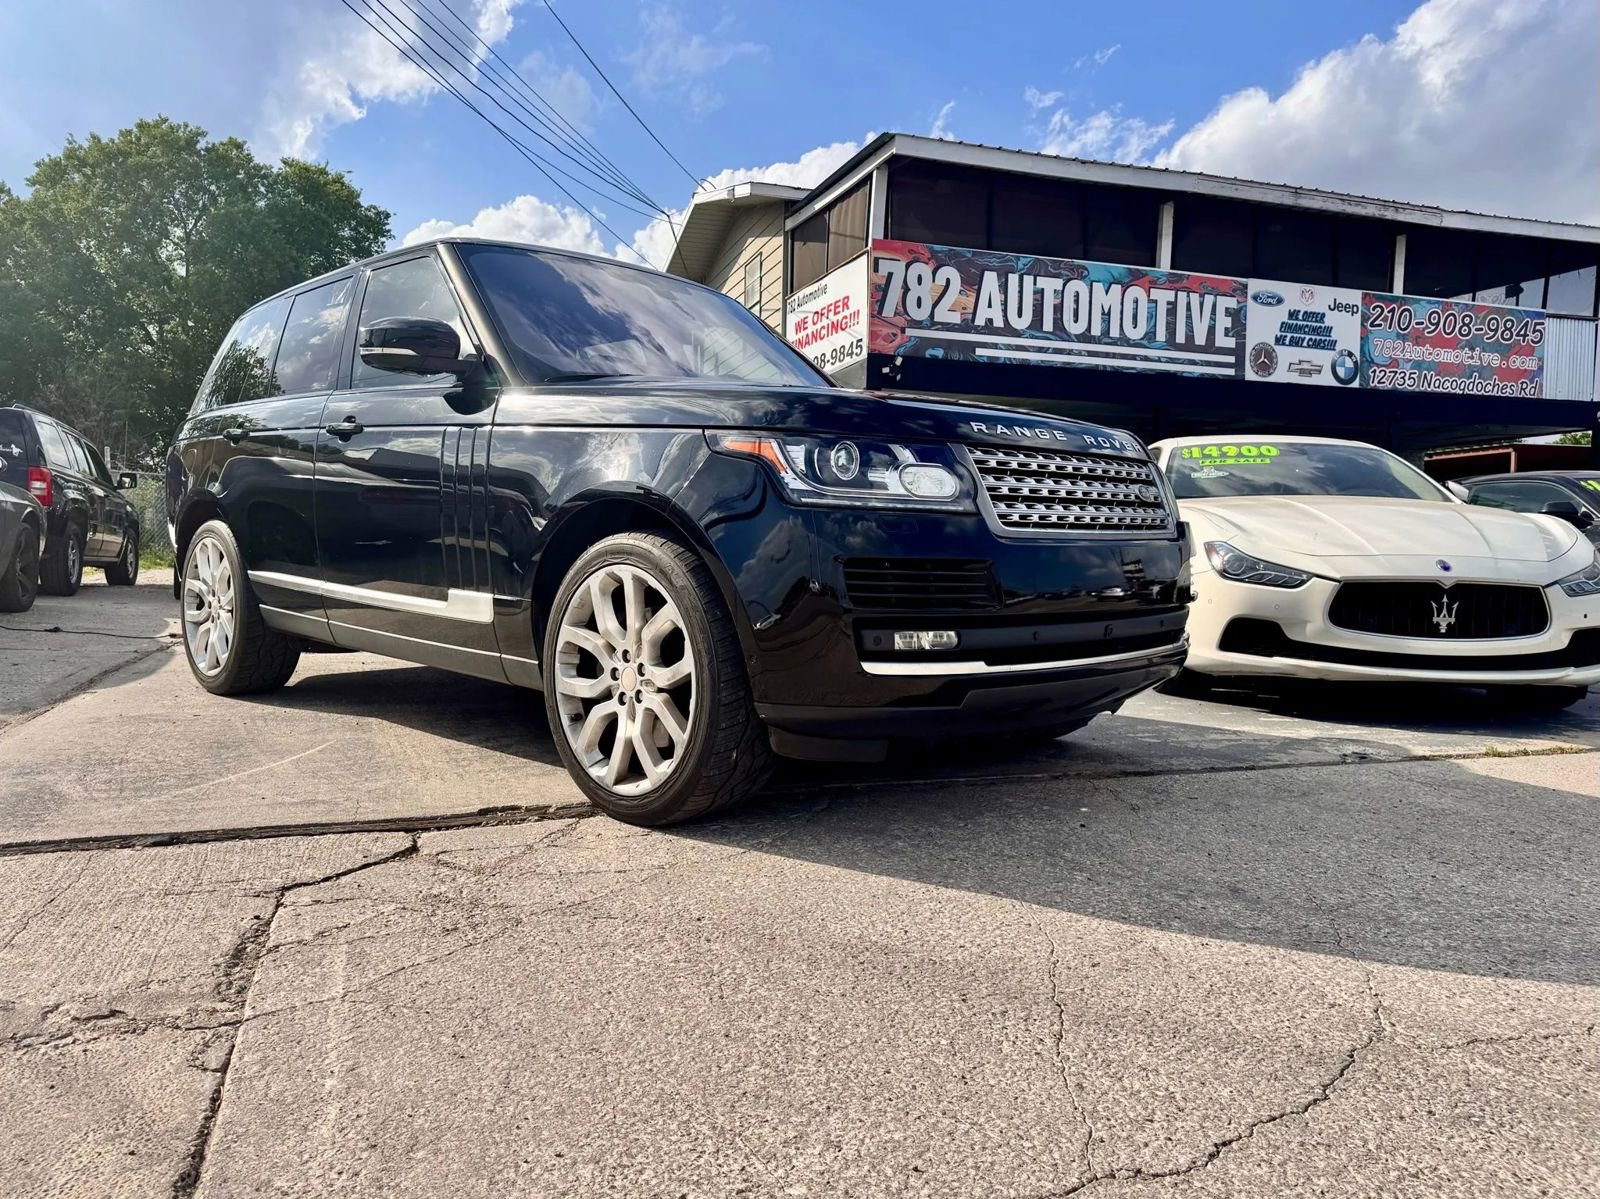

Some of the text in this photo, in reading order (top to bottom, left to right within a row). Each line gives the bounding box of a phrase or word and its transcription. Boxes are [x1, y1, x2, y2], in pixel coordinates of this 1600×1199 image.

[787, 282, 828, 316] 782 Automotive
[878, 260, 1237, 349] 782 AUTOMOTIVE
[1257, 292, 1279, 305] Ford
[1327, 298, 1359, 316] Jeep
[794, 295, 851, 335] WE OFFER
[1287, 309, 1326, 324] WE OFFER
[1368, 302, 1546, 346] 210-908-9845
[1278, 321, 1334, 338] FINANCING!!!
[1273, 334, 1338, 351] WE BUY CARS!!!
[1373, 339, 1539, 369] 782Automotive.com
[1369, 367, 1539, 398] 12735 Nacogdoches Rd
[969, 420, 1143, 454] RANGE ROVER
[1181, 444, 1280, 459] $14900
[1200, 457, 1269, 466] FOR SALE
